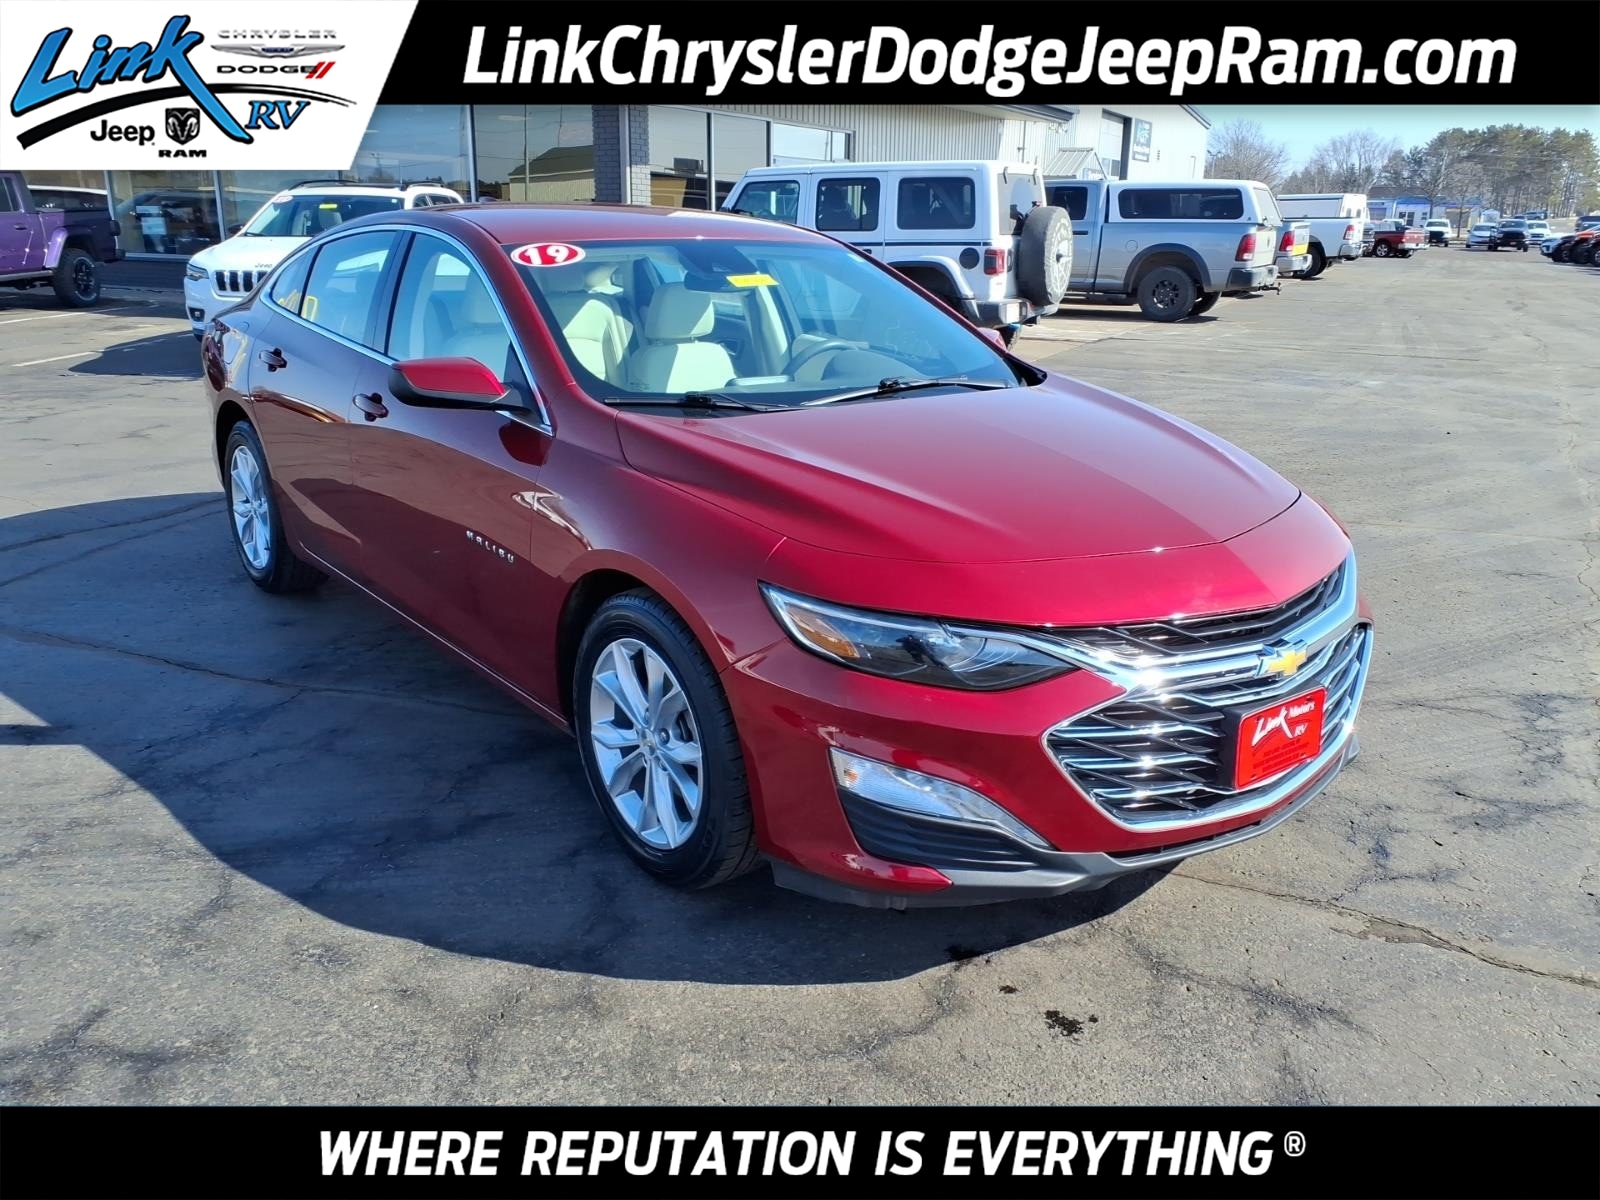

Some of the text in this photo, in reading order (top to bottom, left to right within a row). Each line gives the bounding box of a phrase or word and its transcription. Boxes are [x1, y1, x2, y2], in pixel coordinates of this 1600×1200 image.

[523, 245, 570, 265] 19
[466, 530, 514, 563] MALIBU
[1251, 706, 1294, 747] Link
[1294, 722, 1309, 738] RV
